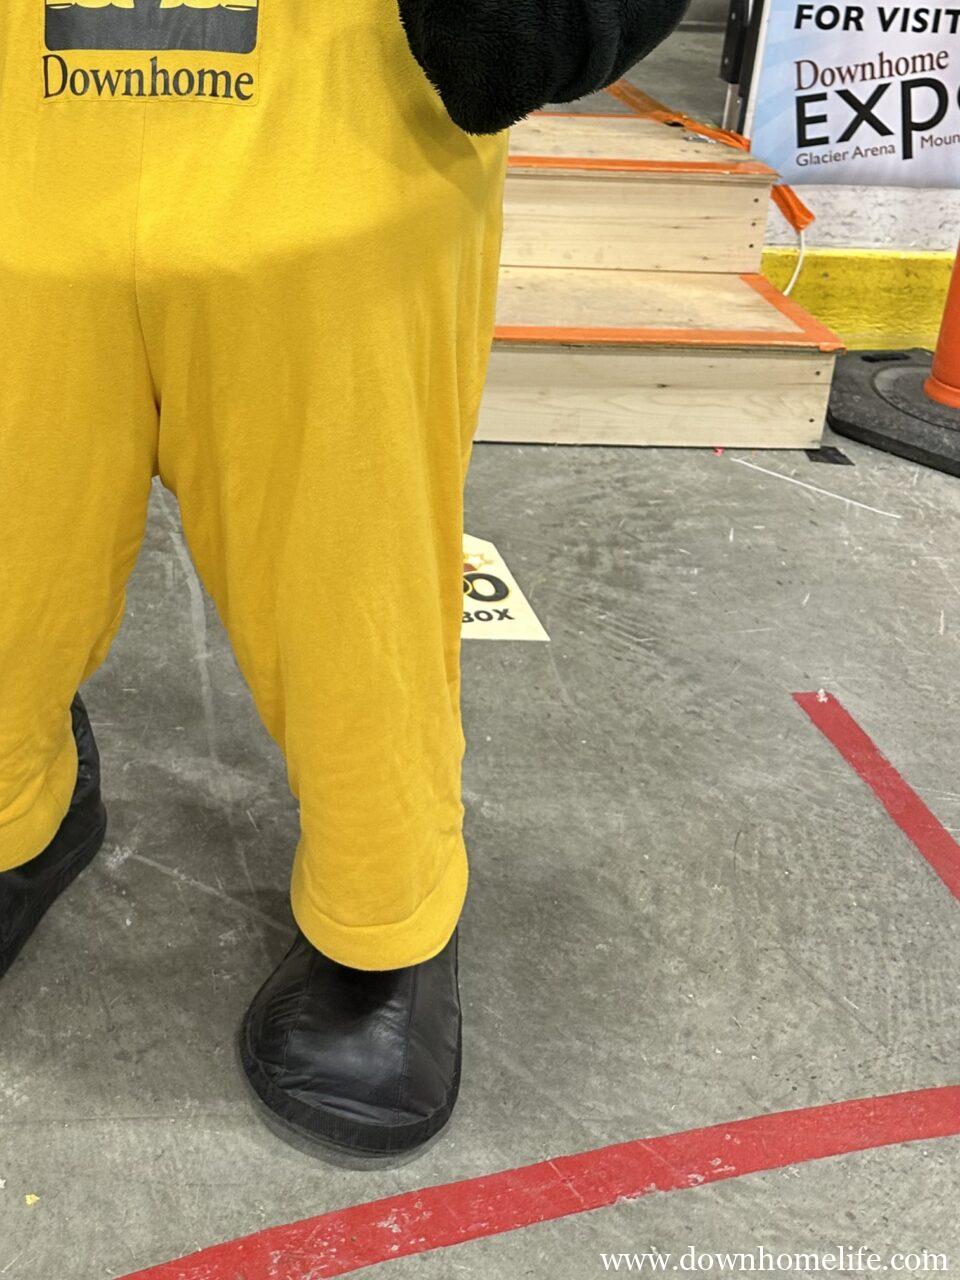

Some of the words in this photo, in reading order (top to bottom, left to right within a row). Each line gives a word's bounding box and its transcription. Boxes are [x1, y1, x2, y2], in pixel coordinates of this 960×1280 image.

[794, 4, 864, 31] FOR
[877, 6, 960, 34] VISIT
[42, 54, 254, 100] Downhome
[794, 50, 949, 91] Downhome
[795, 150, 849, 167] Glacier
[851, 144, 896, 160] Arena
[920, 133, 960, 149] Moun
[461, 608, 515, 623] BOX
